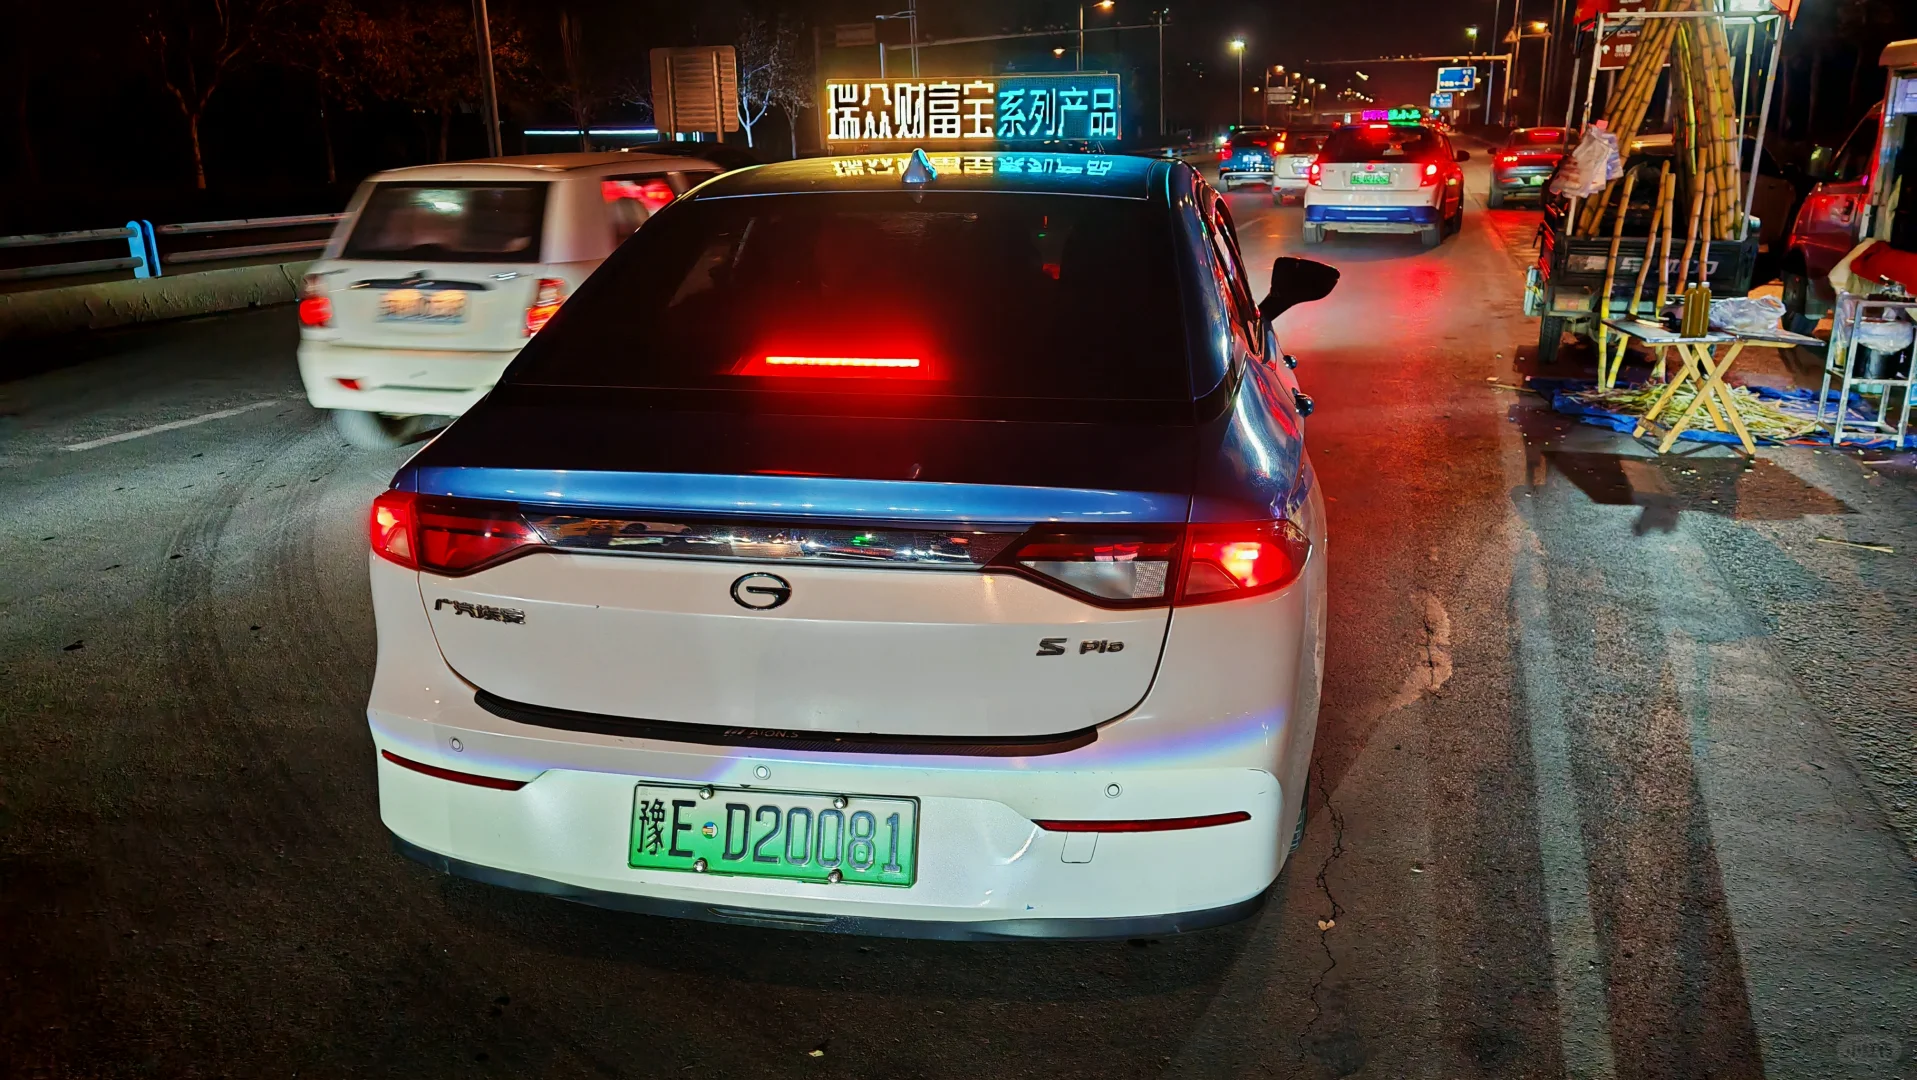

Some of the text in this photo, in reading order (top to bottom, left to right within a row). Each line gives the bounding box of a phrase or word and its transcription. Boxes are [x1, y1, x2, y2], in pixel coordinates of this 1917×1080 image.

[827, 80, 1117, 139] 瑞众财富宝系列产品
[722, 802, 903, 873] D20081
